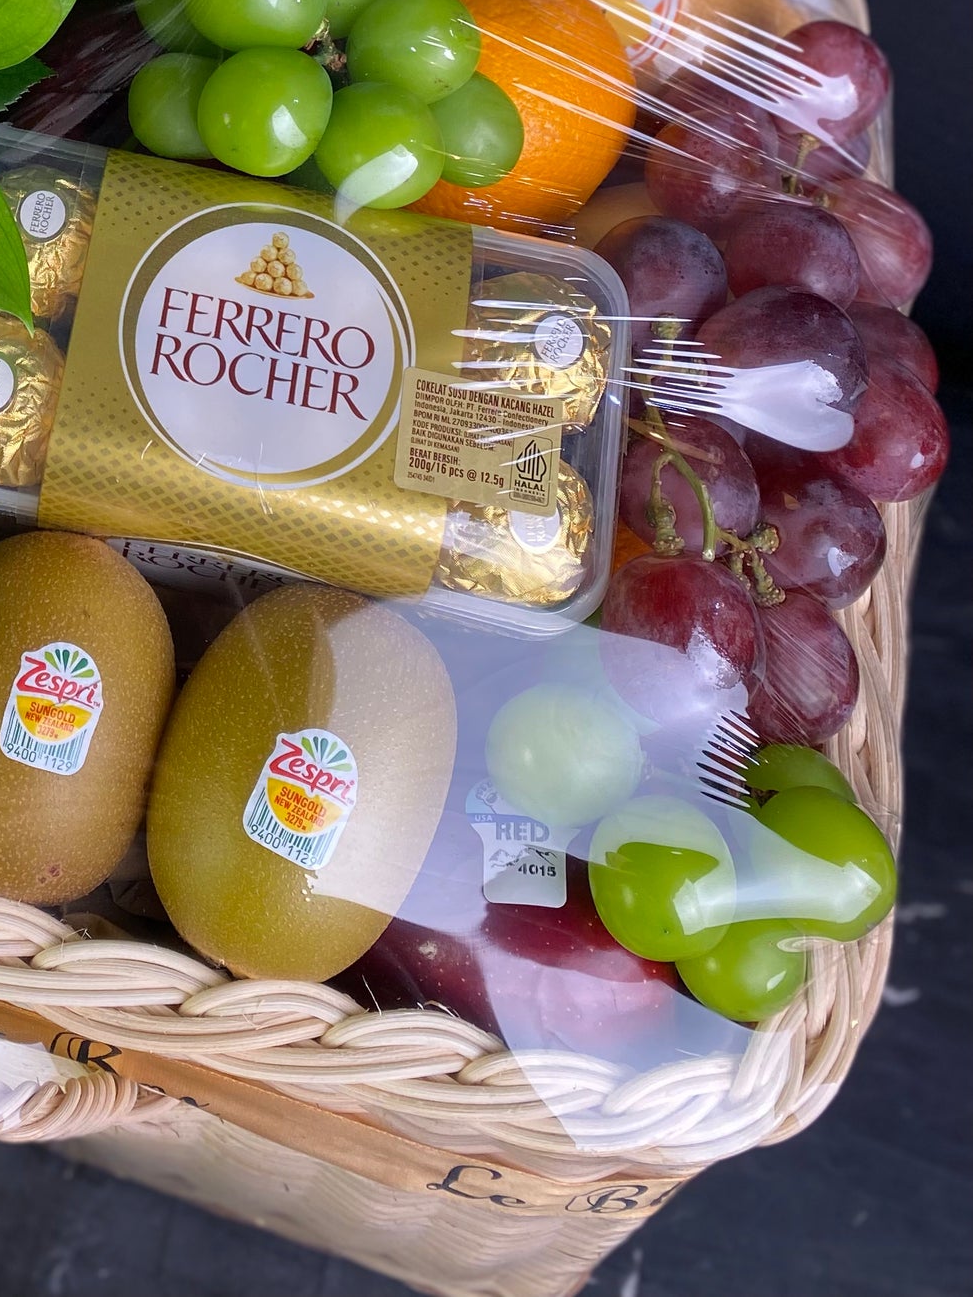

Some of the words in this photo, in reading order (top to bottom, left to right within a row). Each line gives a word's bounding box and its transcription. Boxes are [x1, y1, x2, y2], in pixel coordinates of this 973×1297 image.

[30, 192, 46, 233] FERRERO
[40, 195, 55, 235] ROCHER
[158, 287, 375, 369] FERRERO
[549, 323, 576, 363] ROCHER
[150, 333, 369, 421] ROCHER
[415, 392, 445, 405] DIIMPOR
[503, 410, 549, 426] Confectionery
[417, 379, 447, 395] COKELAT
[448, 386, 468, 400] SUSU
[469, 390, 500, 407] DENGAN
[501, 397, 531, 414] KACANG
[532, 403, 554, 418] HAZEL
[412, 419, 429, 430] KODE
[413, 409, 433, 420] BPOM
[441, 415, 451, 425] ML
[449, 407, 474, 419] Jakarta
[476, 413, 497, 424] 12430
[503, 418, 535, 431] Indonesia
[411, 427, 426, 437] BAIK
[427, 431, 464, 446] DIGUNAKAN
[409, 447, 432, 460] BERAT
[433, 452, 461, 466] BERSIH:
[409, 457, 447, 474] 200g/16
[449, 466, 464, 478] pcs
[467, 469, 477, 481] @
[481, 471, 504, 488] 12.5g
[514, 479, 546, 492] HALAL
[25, 711, 41, 723] NEW
[43, 716, 75, 732] ZEALAND
[29, 701, 76, 723] SUNGOLD
[37, 725, 55, 738] 3279
[6, 742, 36, 763] 9400
[44, 755, 73, 772] 1129
[274, 795, 290, 811] NEW
[291, 804, 325, 828] ZEALAND
[280, 786, 327, 818] SUNGOLD
[284, 811, 303, 829] 3279
[474, 814, 493, 822] USA
[250, 823, 281, 849] 9400
[288, 845, 317, 867] 1129
[495, 822, 550, 843] RED
[517, 863, 557, 878] 4015
[427, 1165, 526, 1208] Le
